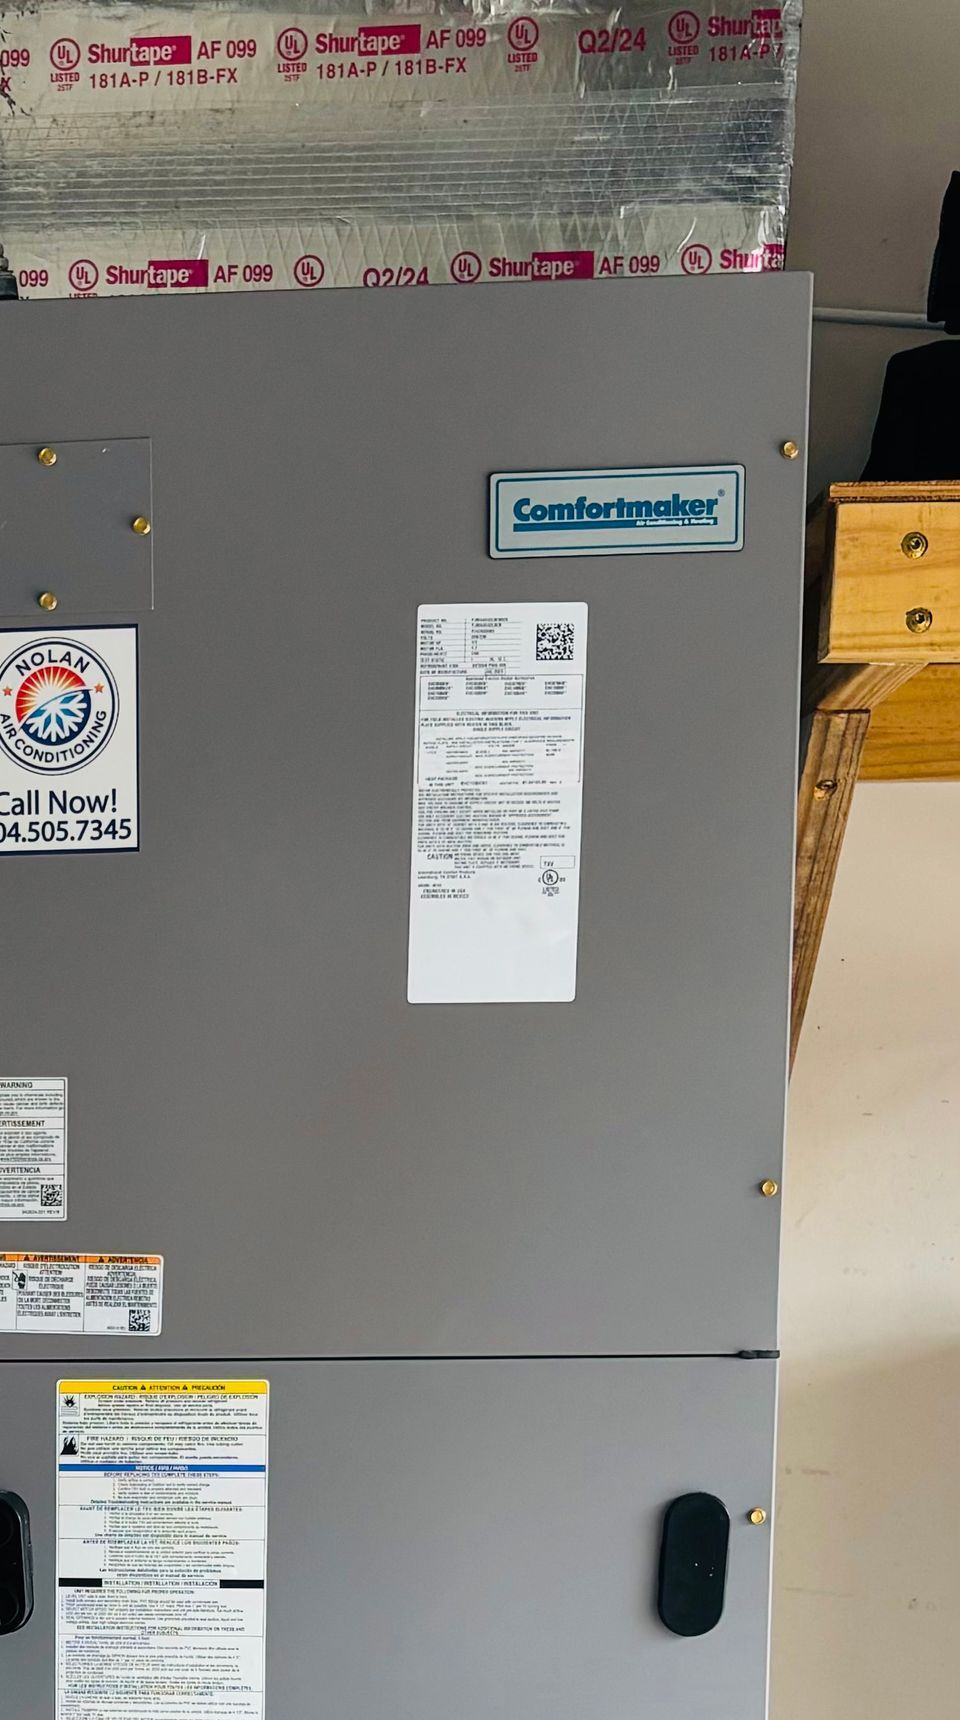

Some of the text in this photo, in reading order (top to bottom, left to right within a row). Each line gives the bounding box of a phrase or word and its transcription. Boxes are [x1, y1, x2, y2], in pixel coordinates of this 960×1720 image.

[88, 40, 257, 66] Shurtape AF 099
[315, 28, 486, 56] Shurtape AF 099
[578, 27, 646, 54] Q2/24
[277, 62, 307, 73] LISTED
[316, 57, 467, 79] 181A-P 181B-FX
[508, 53, 538, 63] LISTED
[50, 72, 80, 83] LISTED
[90, 68, 238, 88] 181A-P 181B-FX
[20, 270, 49, 287] 099
[106, 264, 273, 287] Shurtape AF 099
[489, 254, 660, 280] Shurtape AF 099
[513, 493, 718, 521] Comfortmaker
[15, 649, 90, 676] NOLAN
[0, 709, 108, 764] AIR CONDITIONING
[49, 789, 118, 814] Now!
